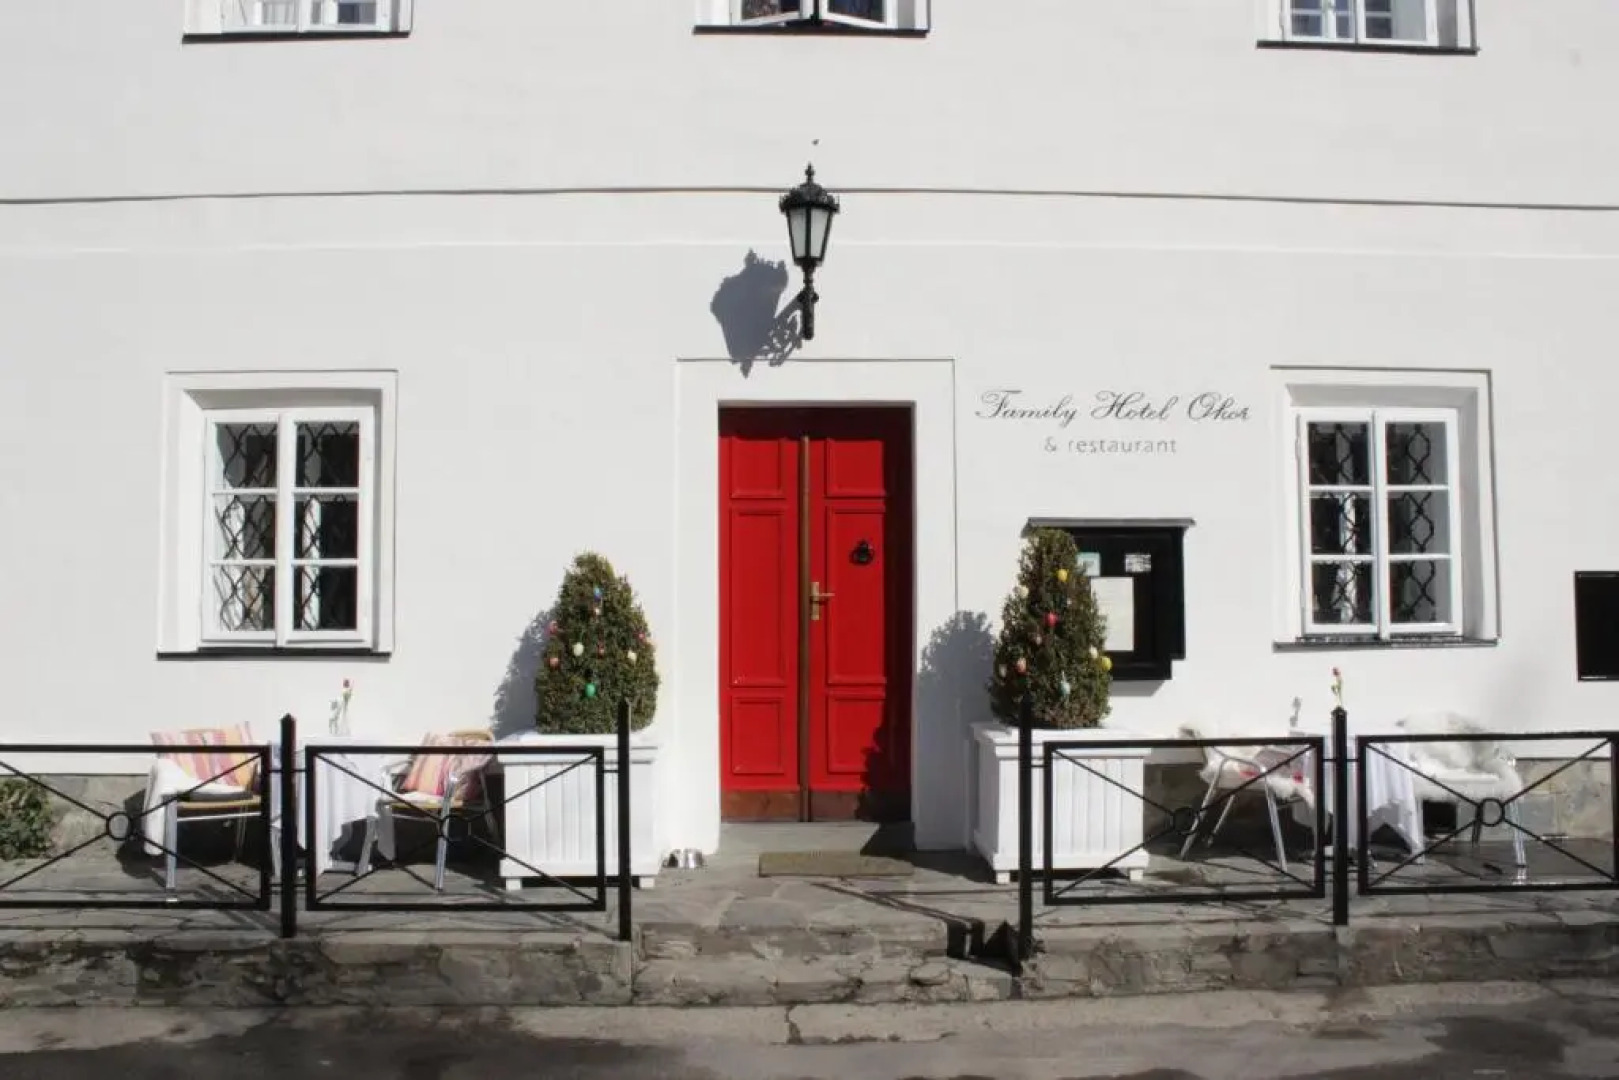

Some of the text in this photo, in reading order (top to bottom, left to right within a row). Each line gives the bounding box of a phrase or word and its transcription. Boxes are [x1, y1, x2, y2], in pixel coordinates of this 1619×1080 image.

[974, 389, 1078, 428] Family
[1090, 390, 1179, 421] Hotel
[1044, 436, 1177, 453] & restaurant
